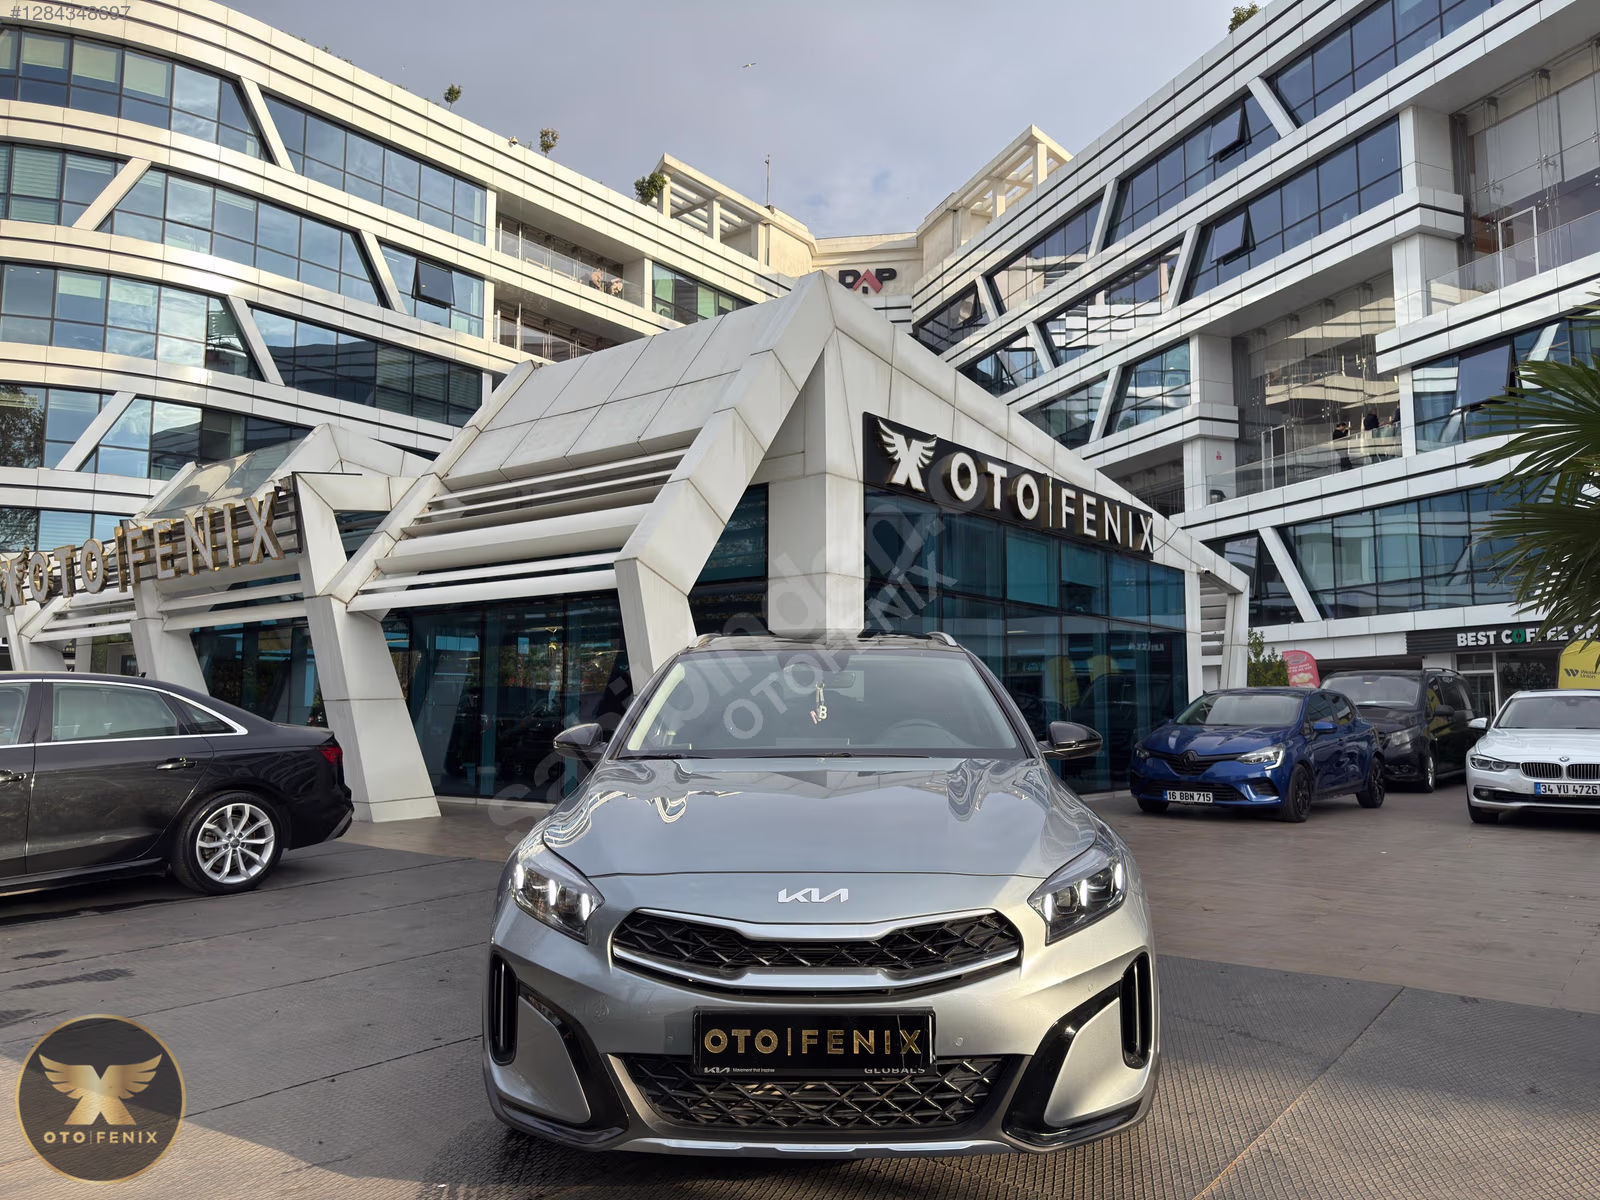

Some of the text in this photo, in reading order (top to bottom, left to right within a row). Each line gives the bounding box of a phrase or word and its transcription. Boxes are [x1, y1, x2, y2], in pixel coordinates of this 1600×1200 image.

[1456, 630, 1497, 647] BEST
[1168, 791, 1212, 802] 16 BBN 715
[1541, 784, 1553, 794] 34
[1572, 784, 1598, 795] 4726
[777, 887, 849, 904] KIA
